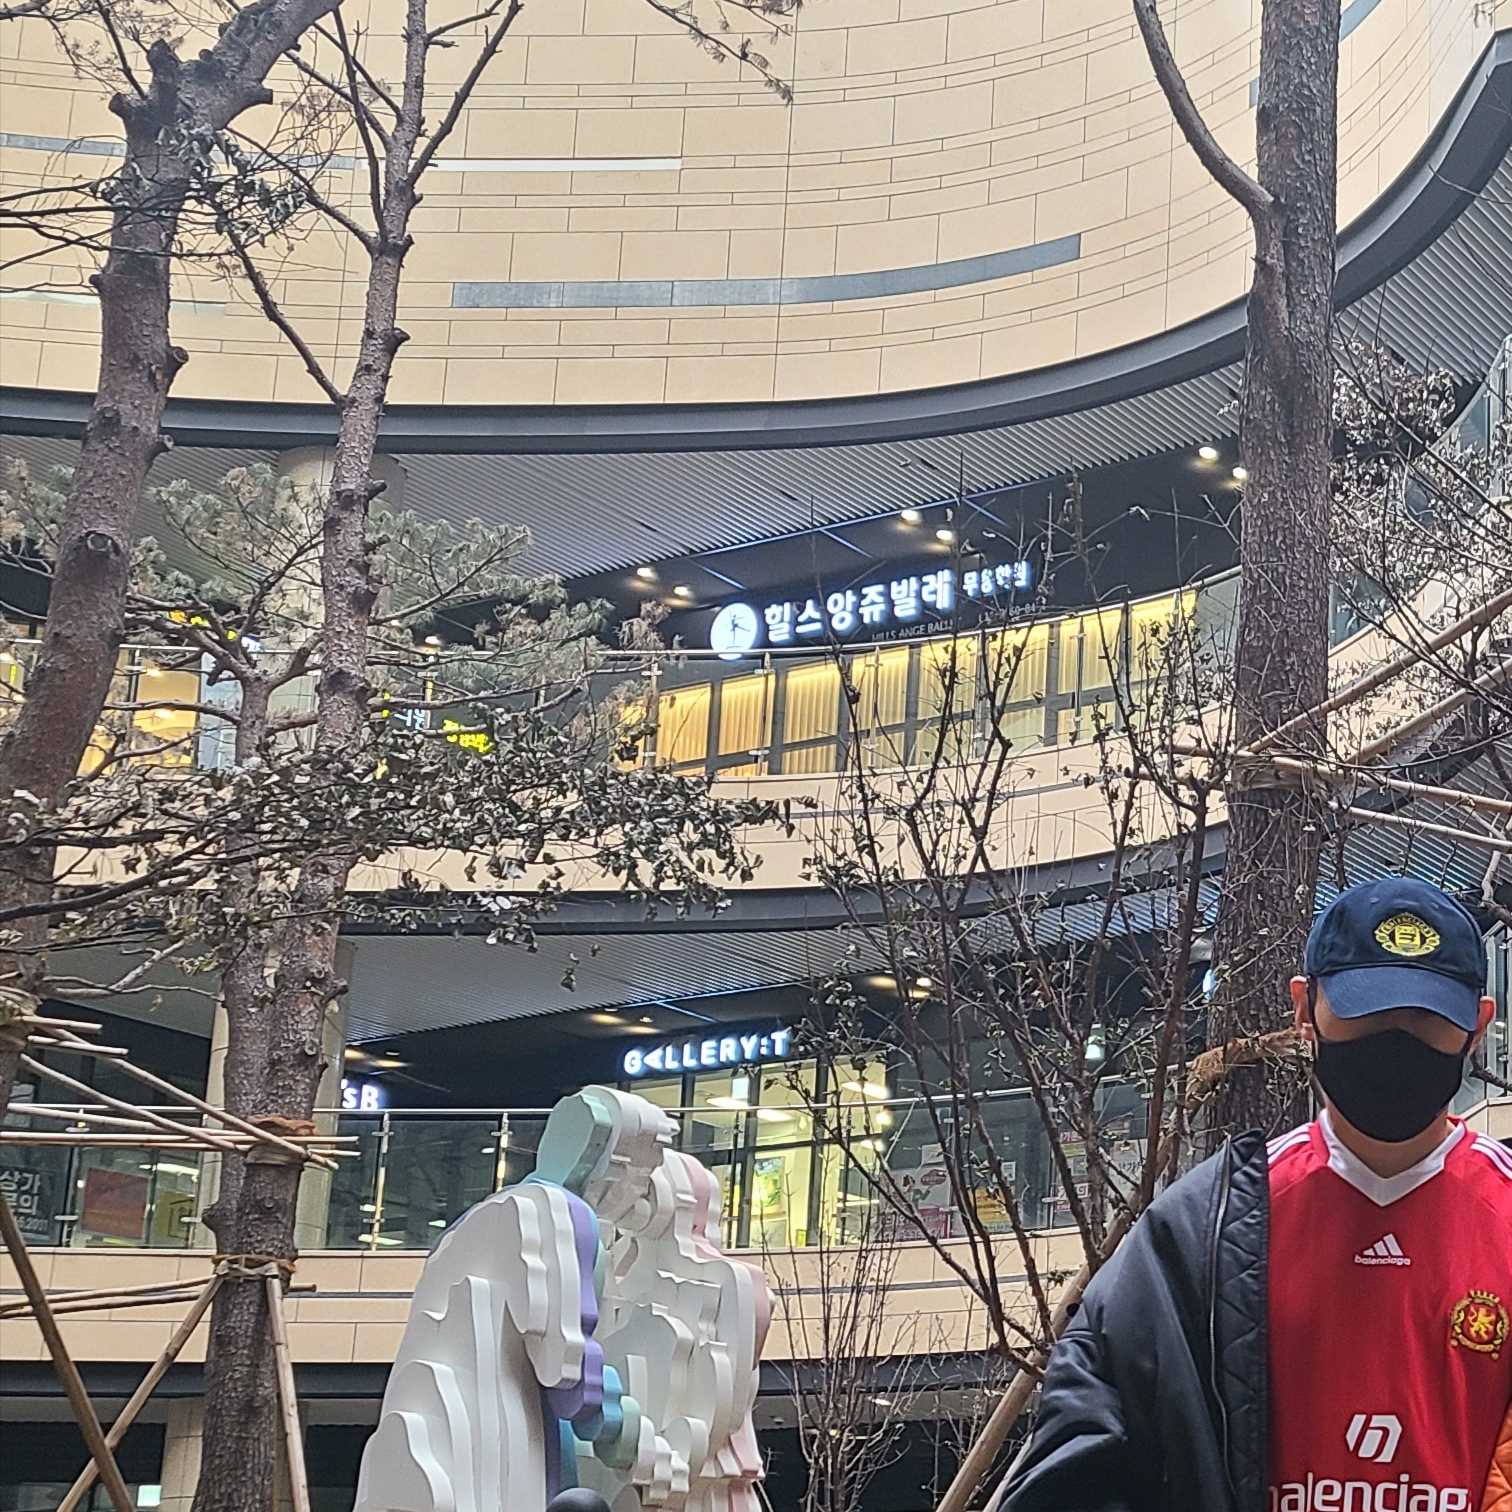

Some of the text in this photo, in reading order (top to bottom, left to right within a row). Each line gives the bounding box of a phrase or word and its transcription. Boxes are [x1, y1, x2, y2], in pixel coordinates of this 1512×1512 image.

[764, 568, 952, 643] 힐스앙쥬발레
[899, 624, 926, 639] ANGE
[1354, 1254, 1411, 1266] balenciaga
